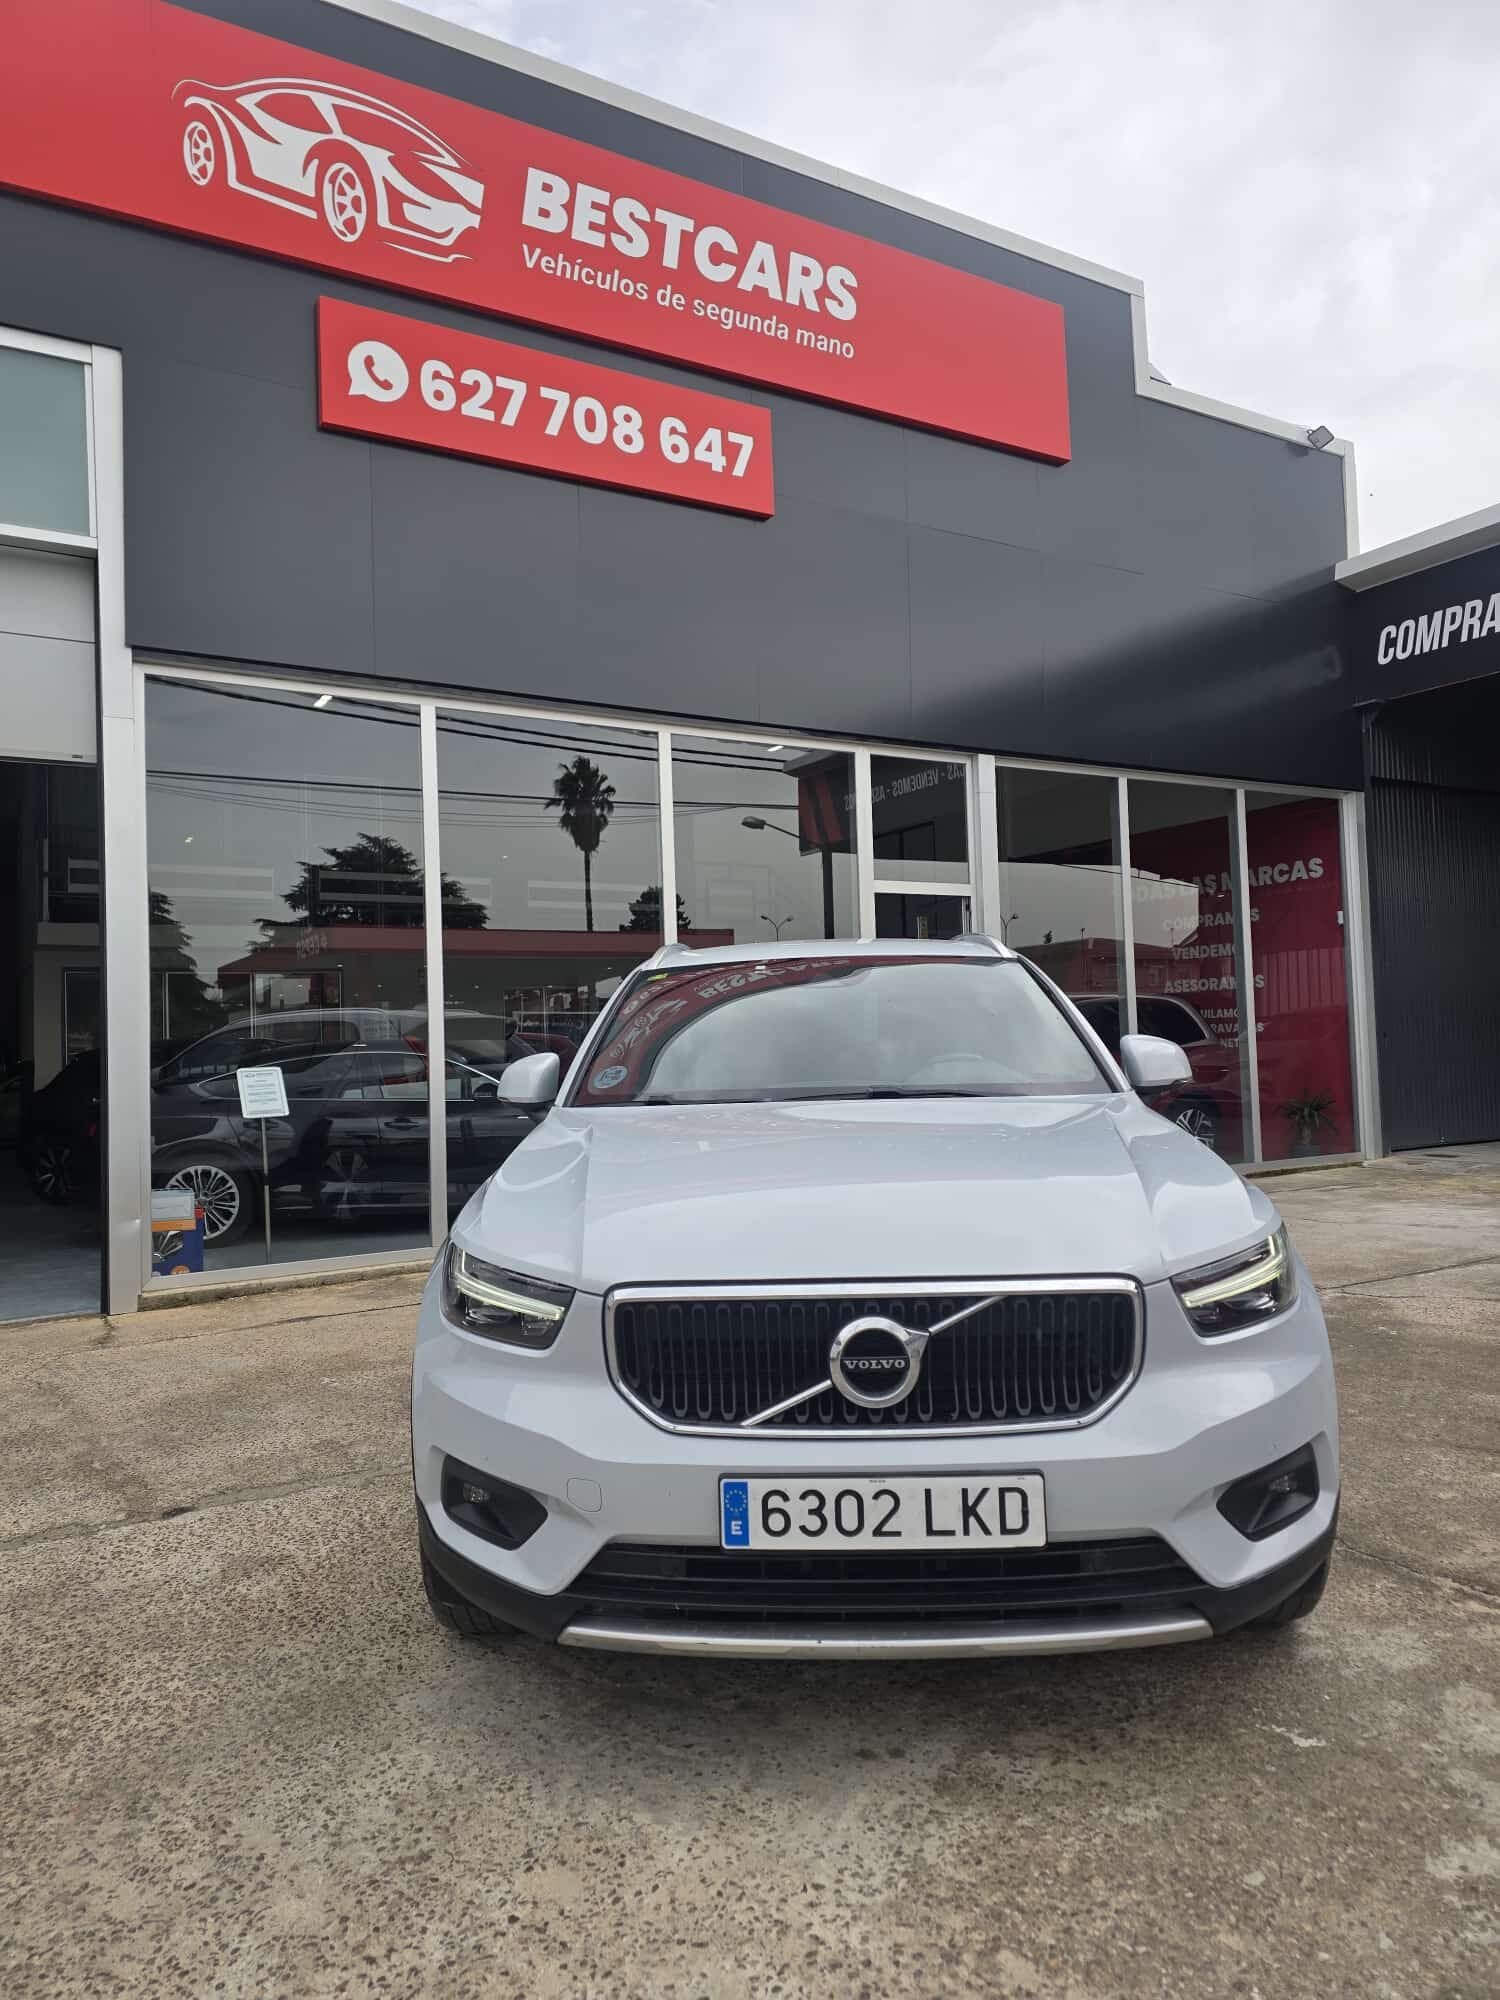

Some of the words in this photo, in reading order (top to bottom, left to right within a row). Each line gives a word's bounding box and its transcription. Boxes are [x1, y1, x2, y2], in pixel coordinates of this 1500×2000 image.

[522, 167, 858, 321] BESTCARS
[522, 244, 649, 300] Vehículos
[656, 284, 686, 311] de
[692, 298, 789, 341] segunda
[795, 329, 855, 359] mano
[420, 359, 528, 427] 627
[539, 386, 645, 454] 708
[659, 416, 754, 477] 647
[1377, 592, 1500, 665] COMPRA
[1162, 907, 1260, 931] COMPRAMS
[1163, 973, 1265, 995] ASESORAMS
[843, 1358, 906, 1370] VOLVO
[730, 1520, 743, 1536] E
[760, 1488, 902, 1538] 6302
[924, 1486, 1030, 1538] LKD
